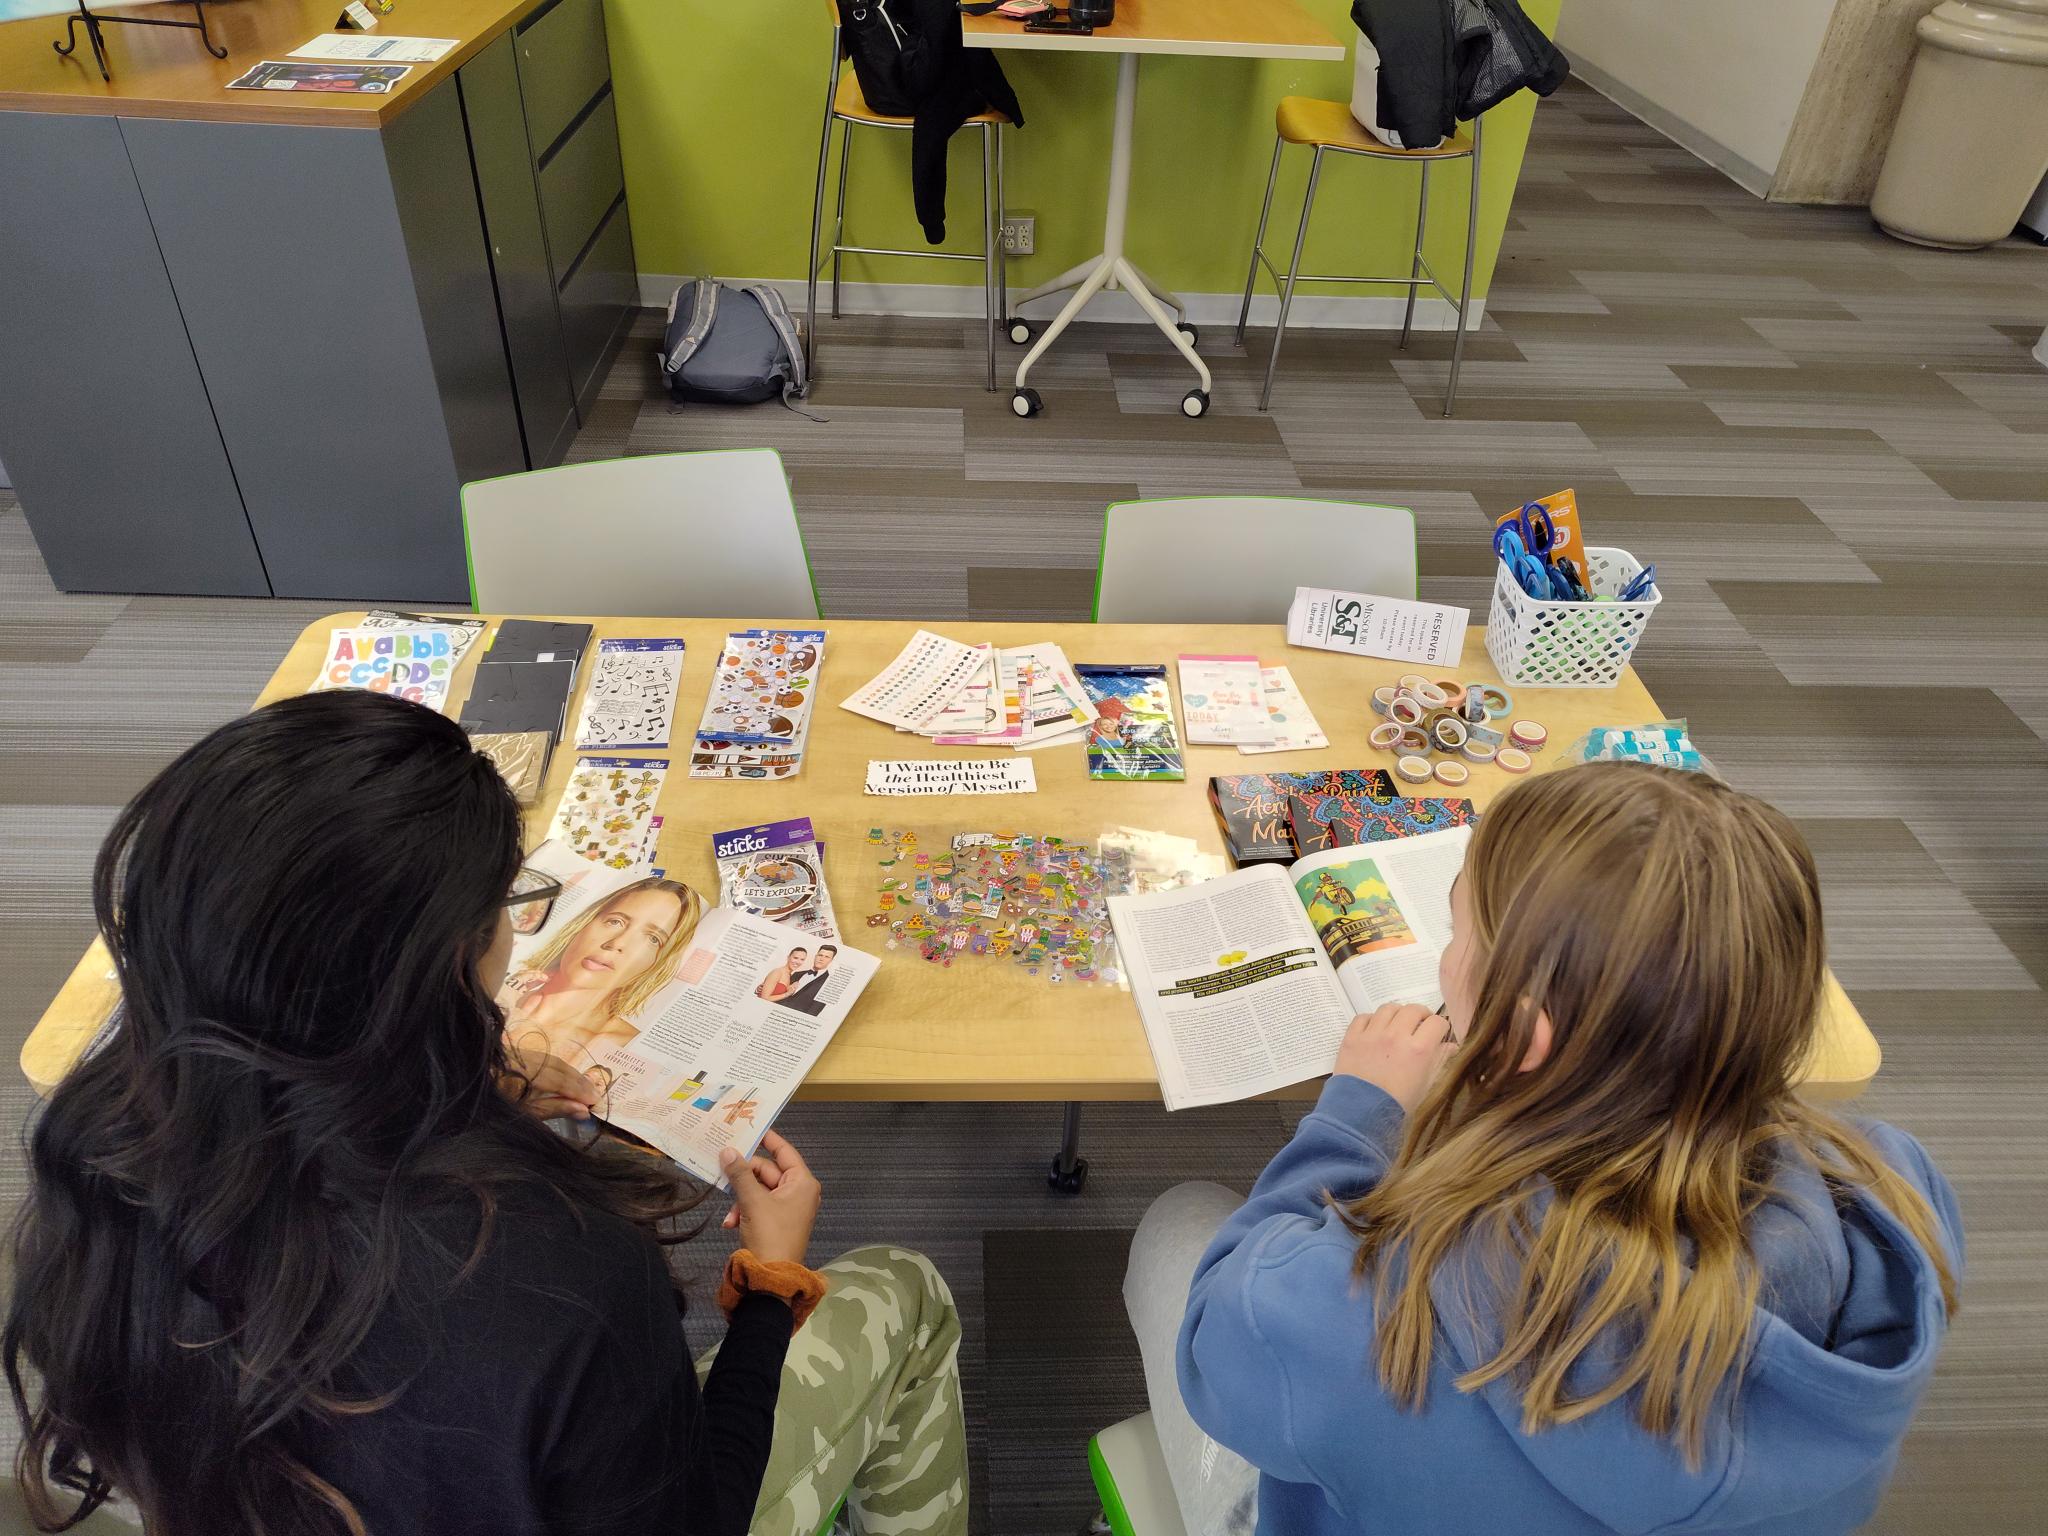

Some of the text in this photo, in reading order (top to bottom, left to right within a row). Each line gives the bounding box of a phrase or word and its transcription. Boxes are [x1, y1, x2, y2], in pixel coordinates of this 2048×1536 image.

[1306, 602, 1319, 635] Libraries
[1315, 602, 1329, 638] University
[1330, 598, 1362, 645] S&T
[1359, 602, 1375, 645] MISSOURI
[334, 638, 354, 661] A
[395, 635, 412, 659] B
[412, 635, 432, 659] b
[432, 633, 451, 656] B
[1427, 612, 1444, 661] RESERVED
[885, 771, 1007, 783] the Healthiest
[896, 761, 963, 773] Wanted
[968, 761, 984, 770] to
[989, 760, 1011, 770] Be
[866, 783, 934, 794] Version
[937, 782, 959, 795] of
[718, 834, 769, 857] sticko
[766, 885, 807, 897] EXPLORE
[1231, 965, 1251, 974] Captain
[1251, 958, 1271, 967] America
[1171, 986, 1194, 994] probably
